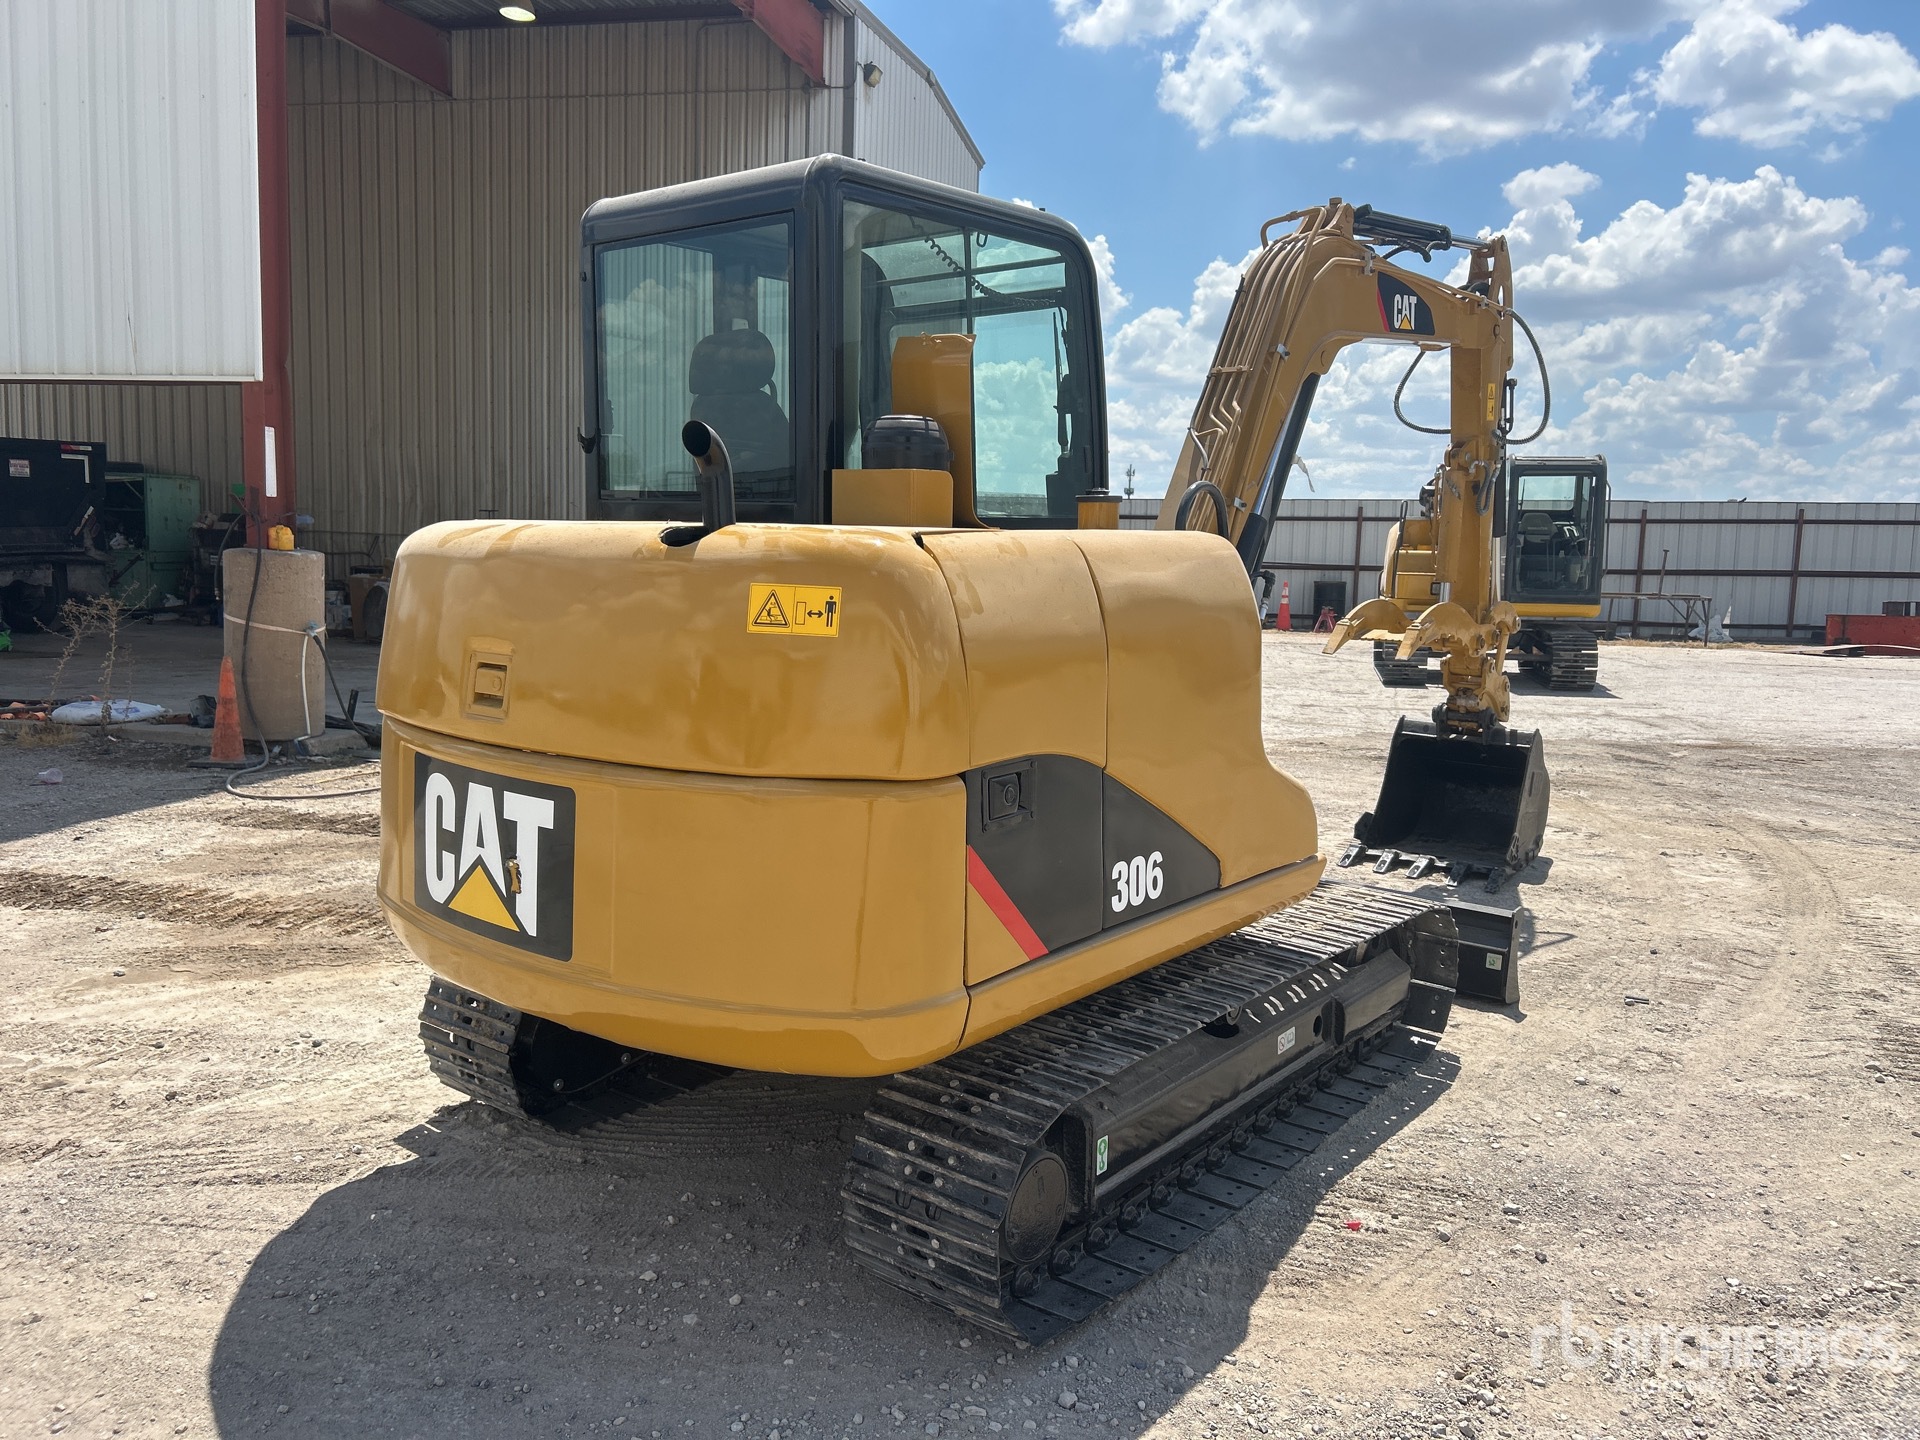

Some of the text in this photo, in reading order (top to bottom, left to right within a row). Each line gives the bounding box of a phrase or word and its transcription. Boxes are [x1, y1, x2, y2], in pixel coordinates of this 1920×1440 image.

[1393, 293, 1417, 330] CAT
[425, 772, 554, 937] CAT
[1111, 850, 1164, 912] 306
